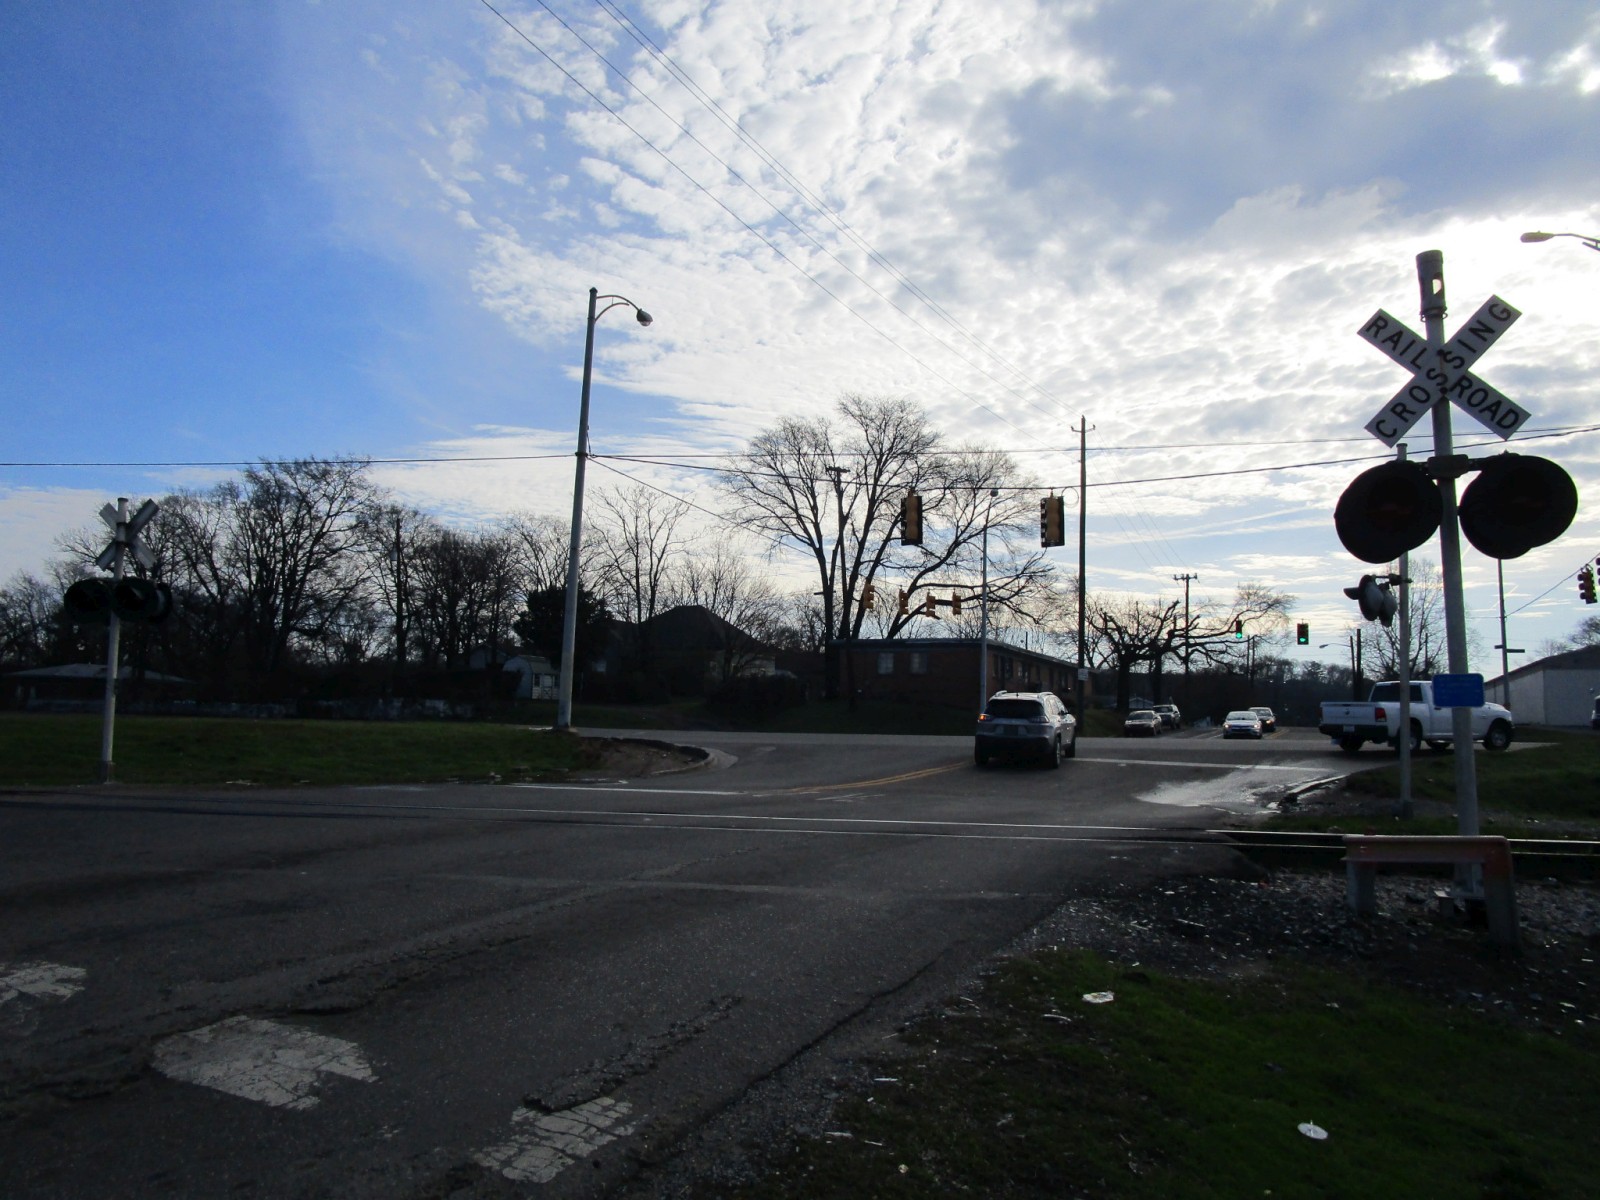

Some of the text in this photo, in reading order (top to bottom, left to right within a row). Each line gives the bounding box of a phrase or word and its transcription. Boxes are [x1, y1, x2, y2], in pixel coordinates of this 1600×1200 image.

[1365, 315, 1520, 430] RAIL ROAD
[1375, 303, 1511, 439] CROSSING
